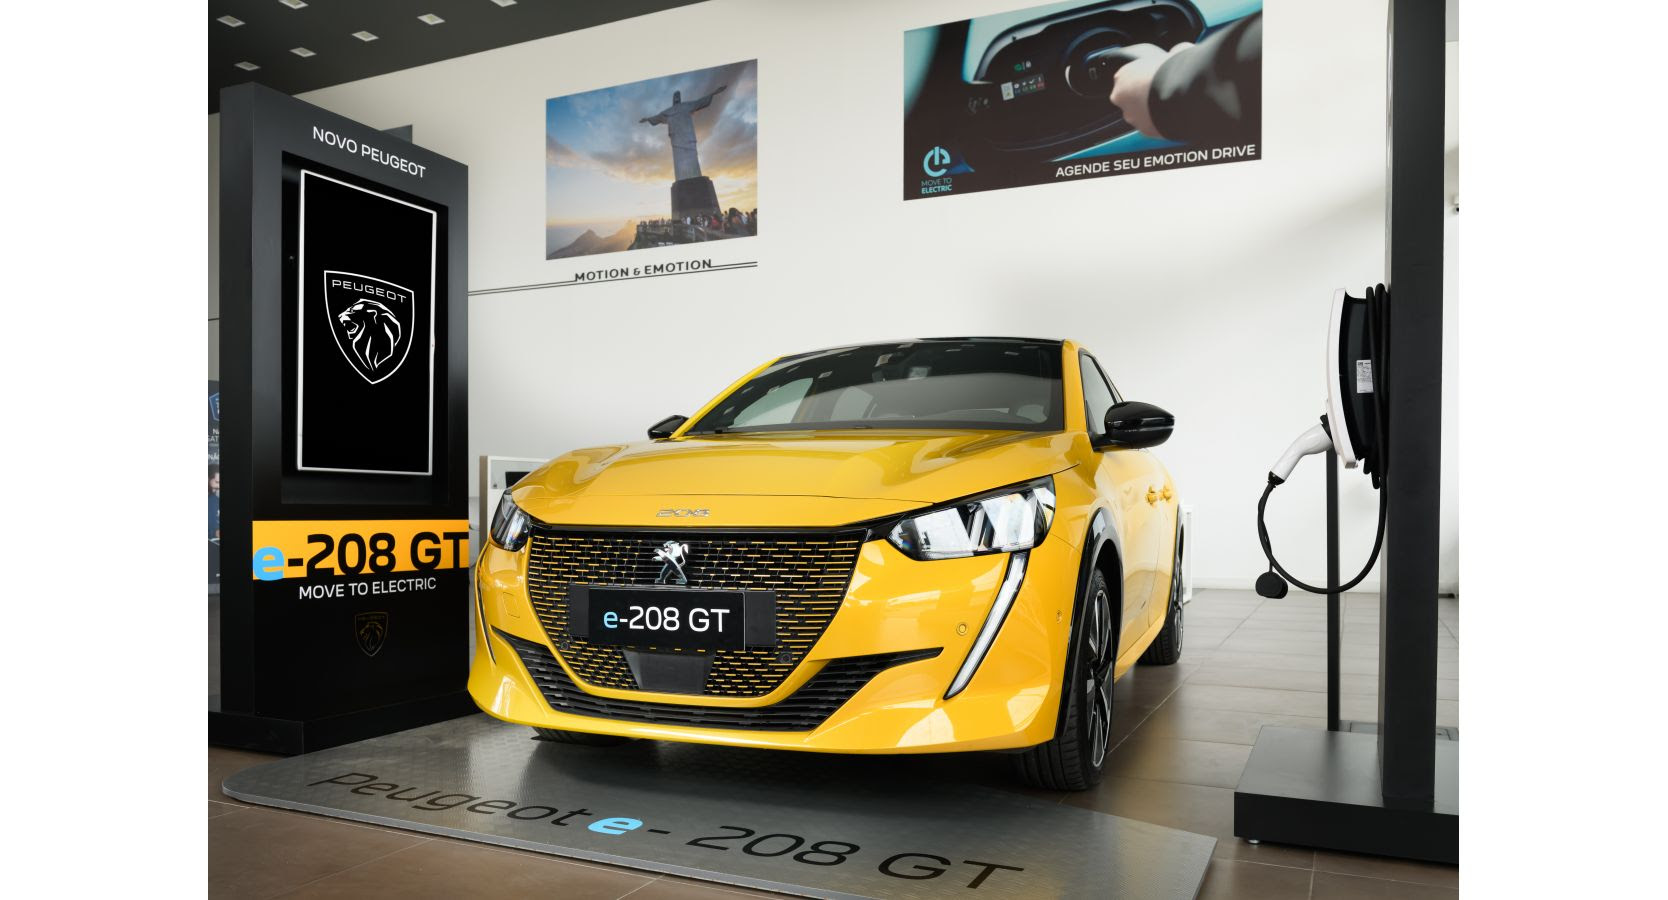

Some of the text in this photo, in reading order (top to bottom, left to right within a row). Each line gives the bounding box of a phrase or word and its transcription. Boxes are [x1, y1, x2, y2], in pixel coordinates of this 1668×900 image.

[312, 125, 427, 179] NOVO PEUGEOT
[1055, 143, 1257, 178] AGENDE SEU EMOTION DRIVE
[921, 179, 942, 187] MOVE
[921, 184, 953, 194] ELECTRIC
[574, 267, 629, 283] MOTION
[644, 258, 713, 275] EMOTION
[331, 279, 407, 304] PEUGEOT
[252, 531, 469, 582] e-208 GT
[298, 577, 437, 600] MOVE TO ELECTRIC
[603, 605, 730, 633] e-208 GT
[307, 772, 593, 827] Peugeot
[877, 852, 1025, 890] GT
